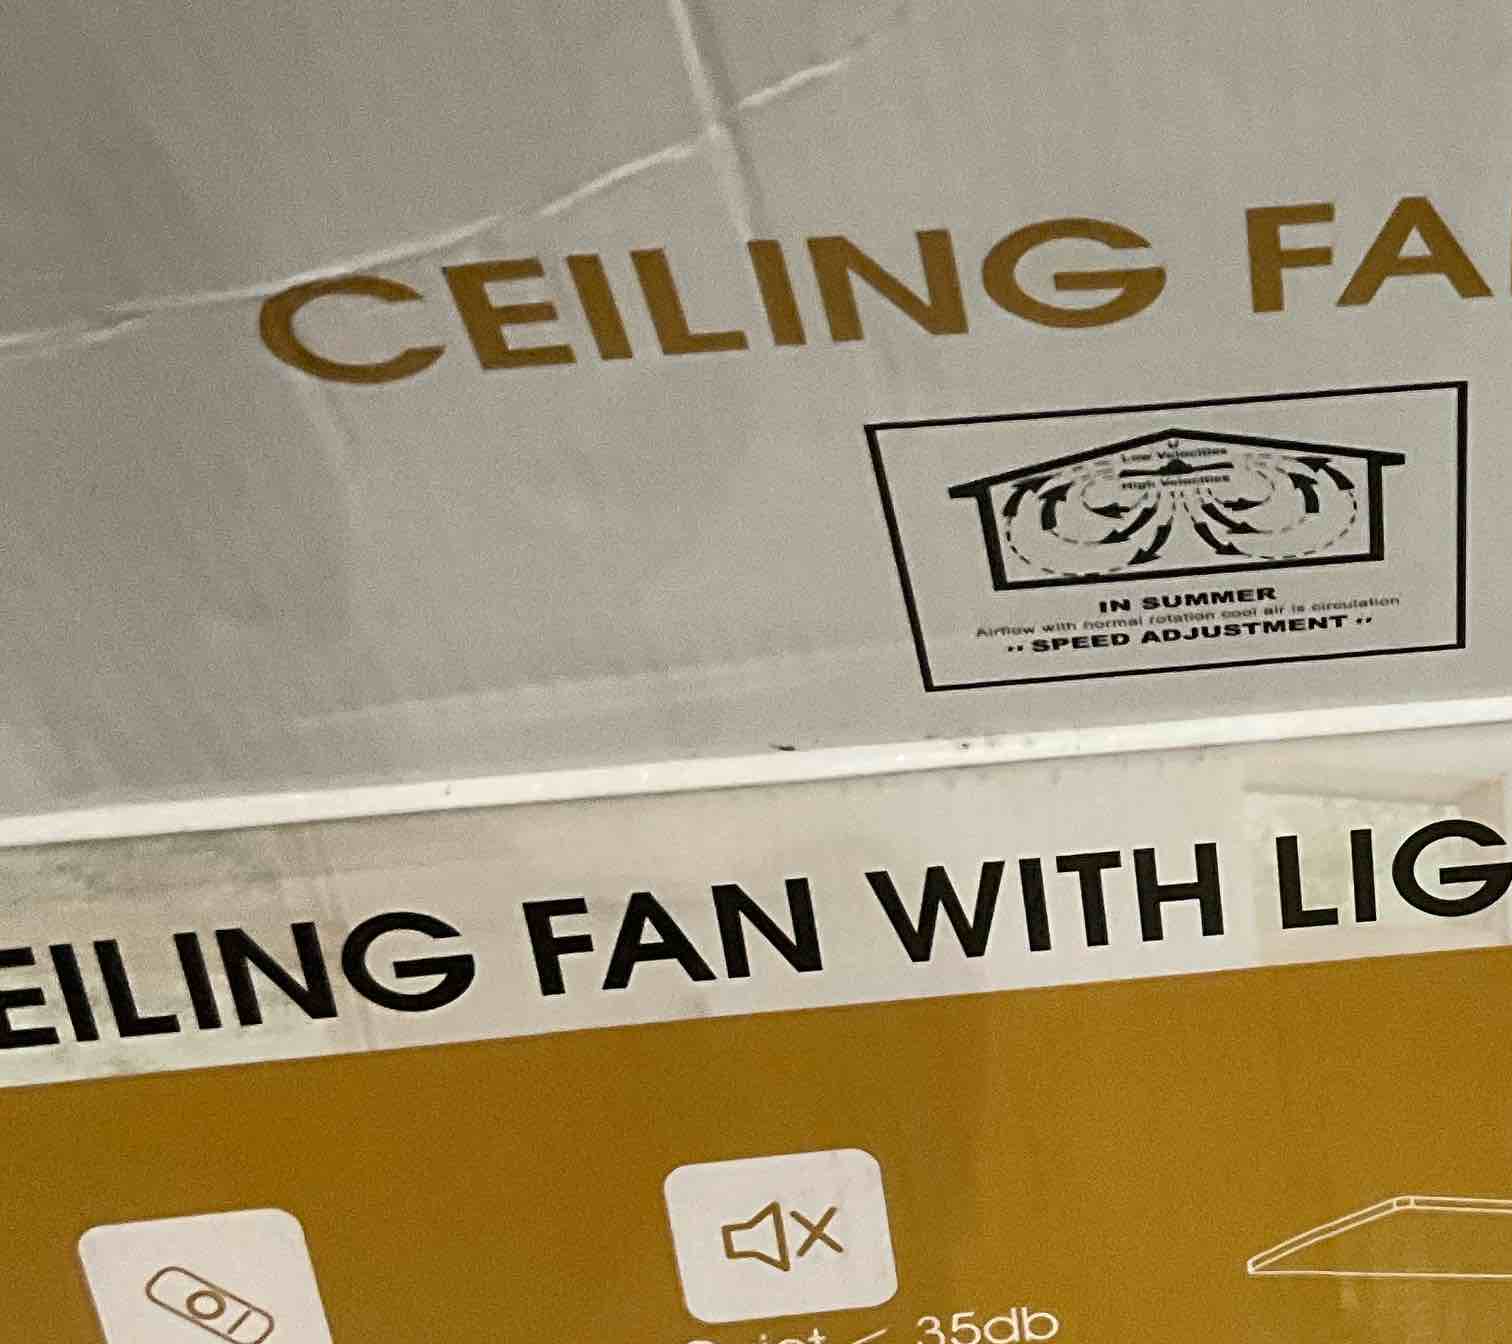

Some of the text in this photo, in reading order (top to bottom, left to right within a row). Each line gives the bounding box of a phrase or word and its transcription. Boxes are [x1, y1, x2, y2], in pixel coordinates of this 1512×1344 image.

[258, 216, 1168, 385] CEILING
[975, 624, 1035, 639] Airflow
[1042, 620, 1078, 633] with
[1083, 615, 1144, 629] normal
[1149, 609, 1214, 624] rotation
[1263, 604, 1286, 615] air
[1311, 595, 1400, 613] circulation
[1098, 587, 1277, 614] IN SUMMER
[521, 876, 824, 997] FAN
[865, 842, 1226, 963] WITH
